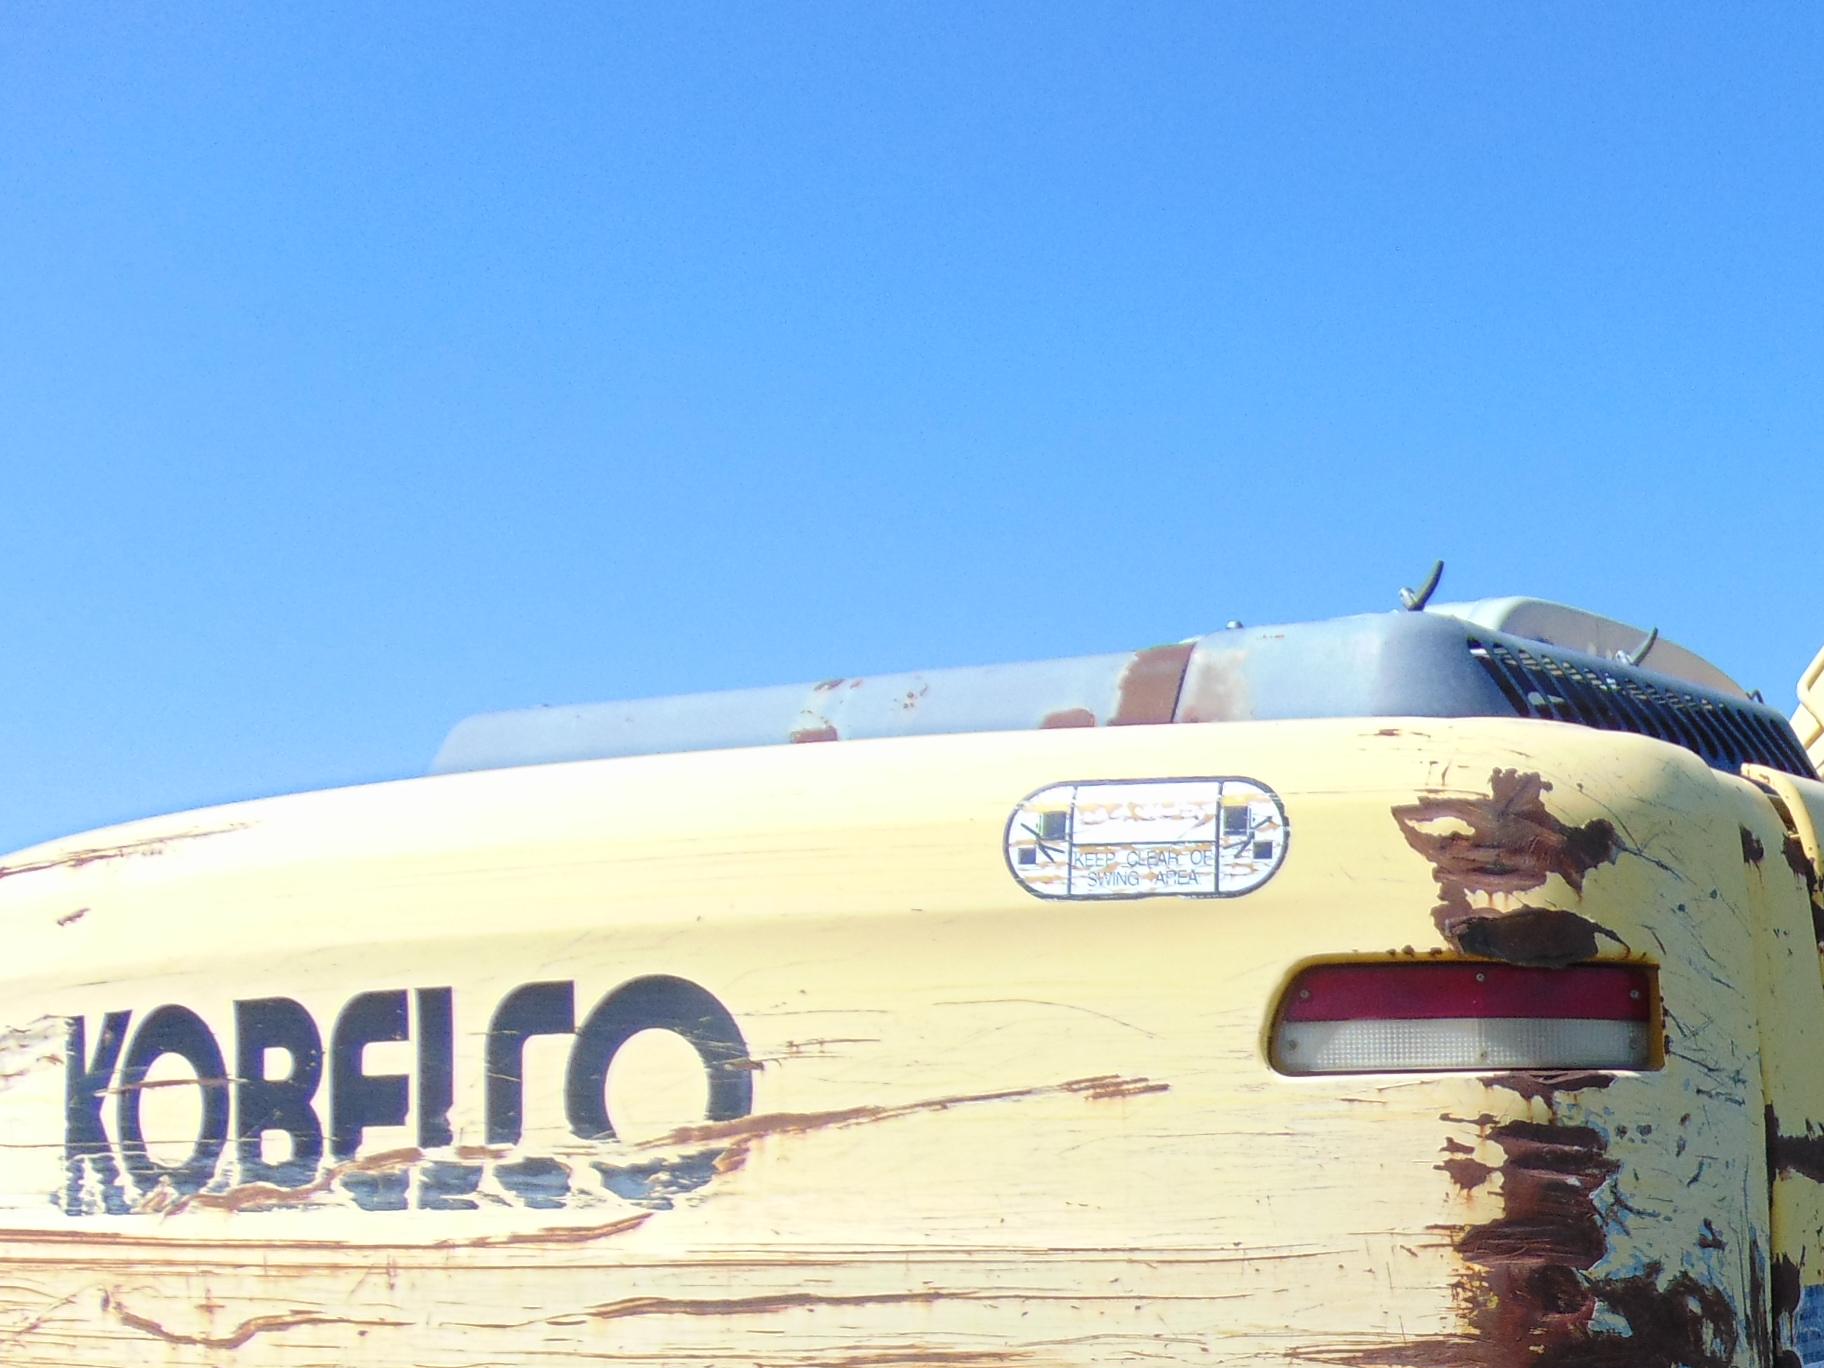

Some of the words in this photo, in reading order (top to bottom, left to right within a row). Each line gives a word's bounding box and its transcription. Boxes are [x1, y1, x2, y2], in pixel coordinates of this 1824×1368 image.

[1074, 850, 1116, 868] KEEP
[1190, 848, 1214, 866] OF
[1087, 869, 1140, 888] SWING
[1155, 868, 1200, 886] AREA
[52, 973, 754, 1217] KOBELCO
